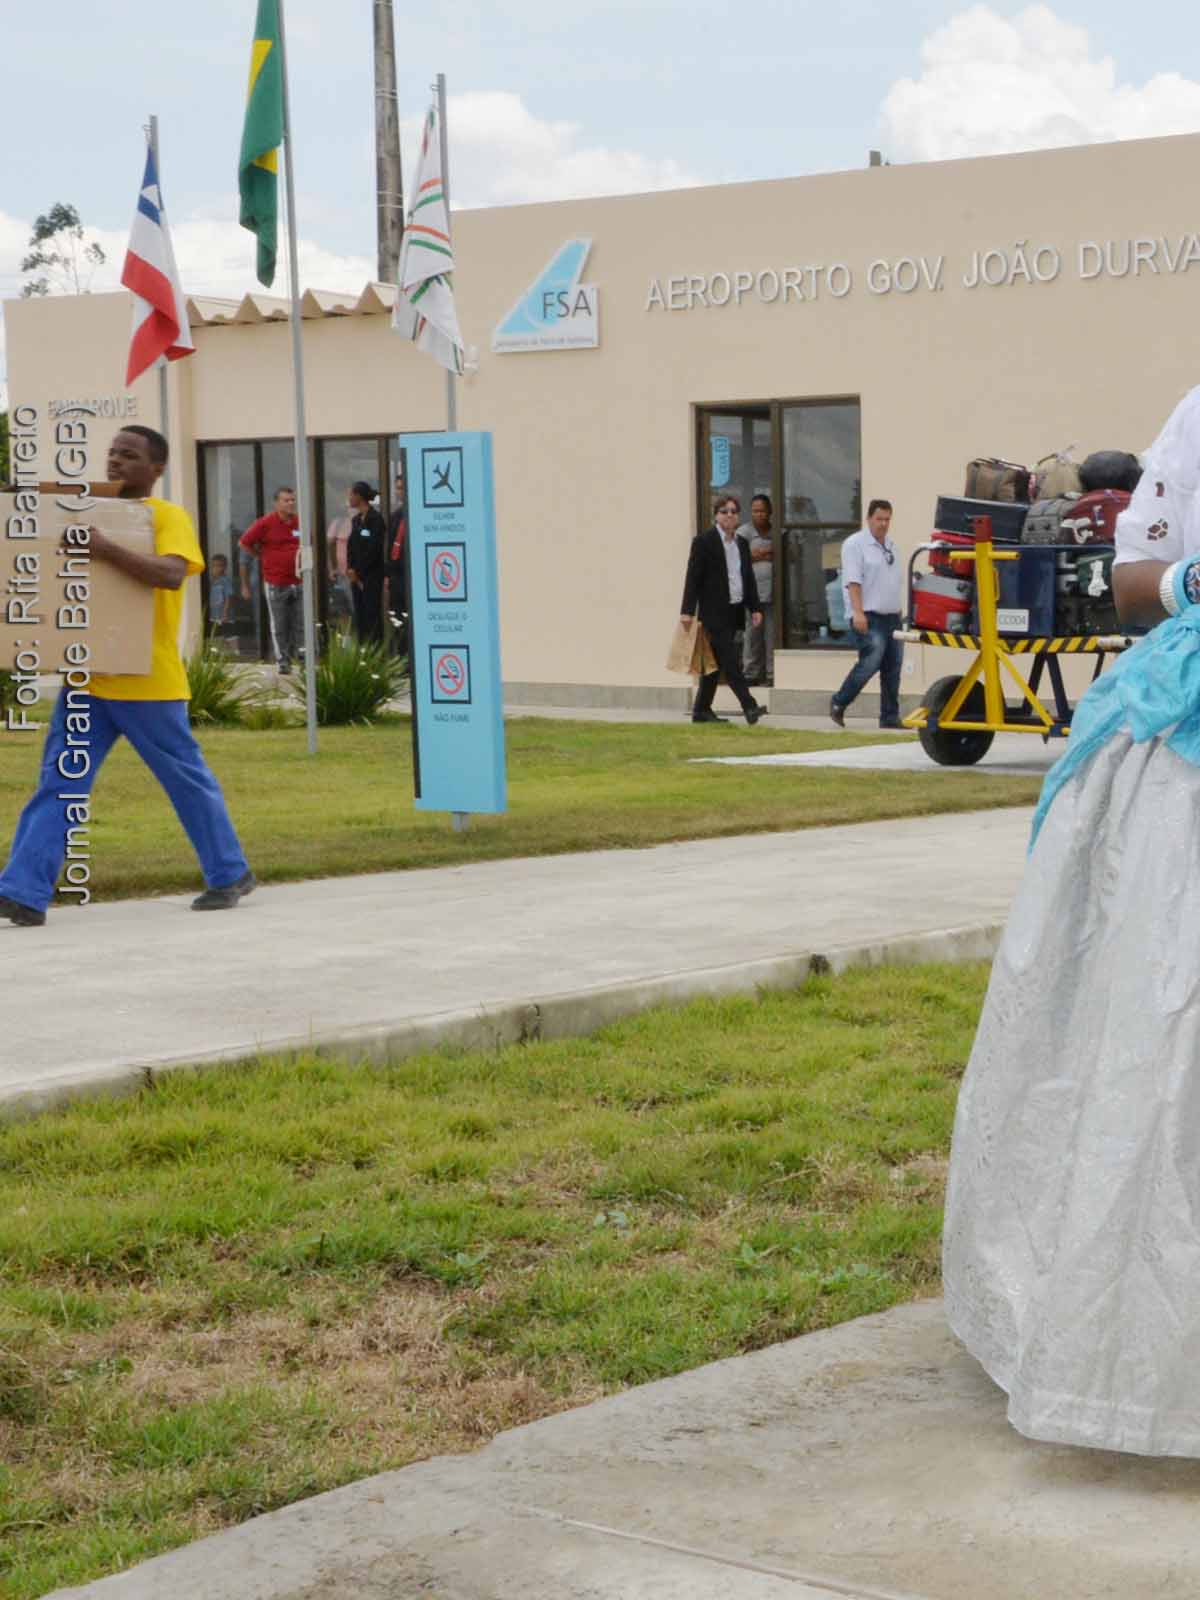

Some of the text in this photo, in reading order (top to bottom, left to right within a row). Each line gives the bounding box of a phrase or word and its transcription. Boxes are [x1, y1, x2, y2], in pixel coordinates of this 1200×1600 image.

[646, 264, 853, 312] AEROPORTO
[962, 240, 1061, 288] JOÃO
[542, 288, 592, 319] FSA
